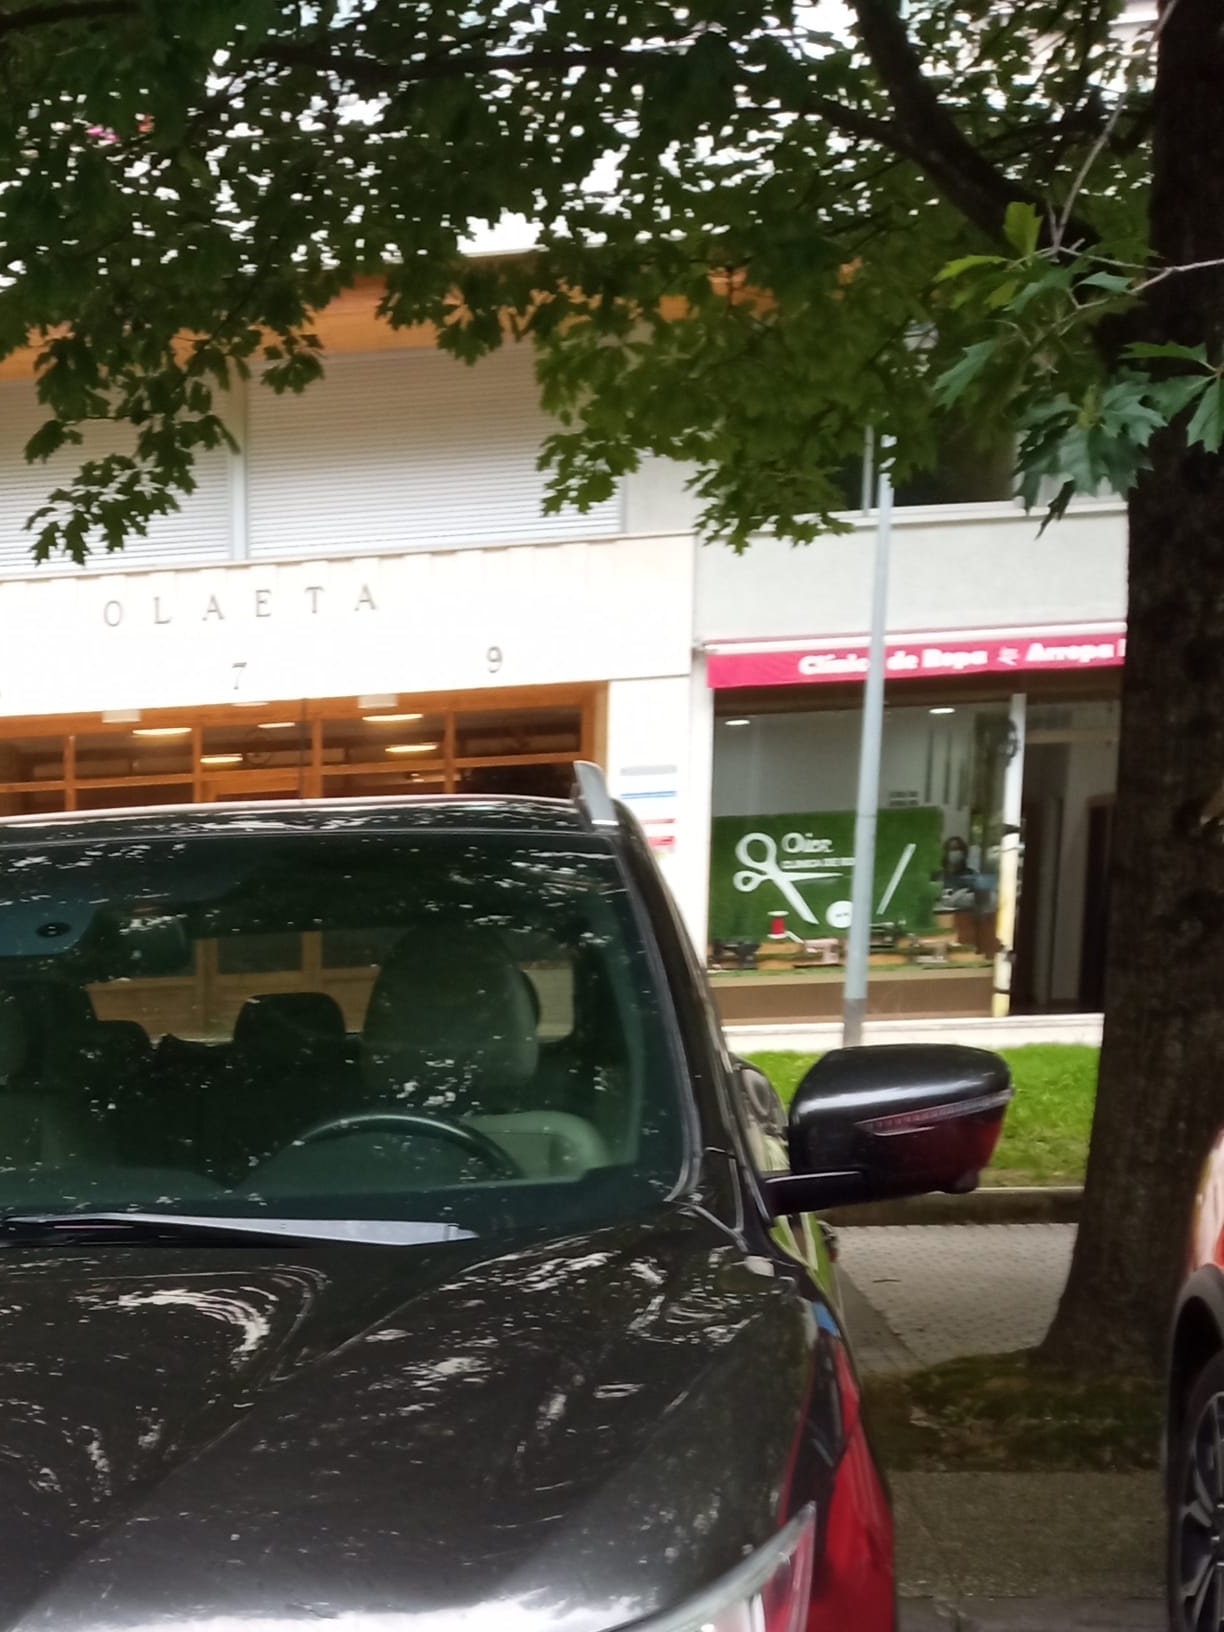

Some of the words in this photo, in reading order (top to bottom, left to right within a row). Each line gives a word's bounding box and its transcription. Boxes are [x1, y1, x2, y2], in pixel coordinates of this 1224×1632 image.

[103, 583, 377, 628] OLAETA
[486, 645, 504, 674] 9
[231, 661, 248, 691] 7
